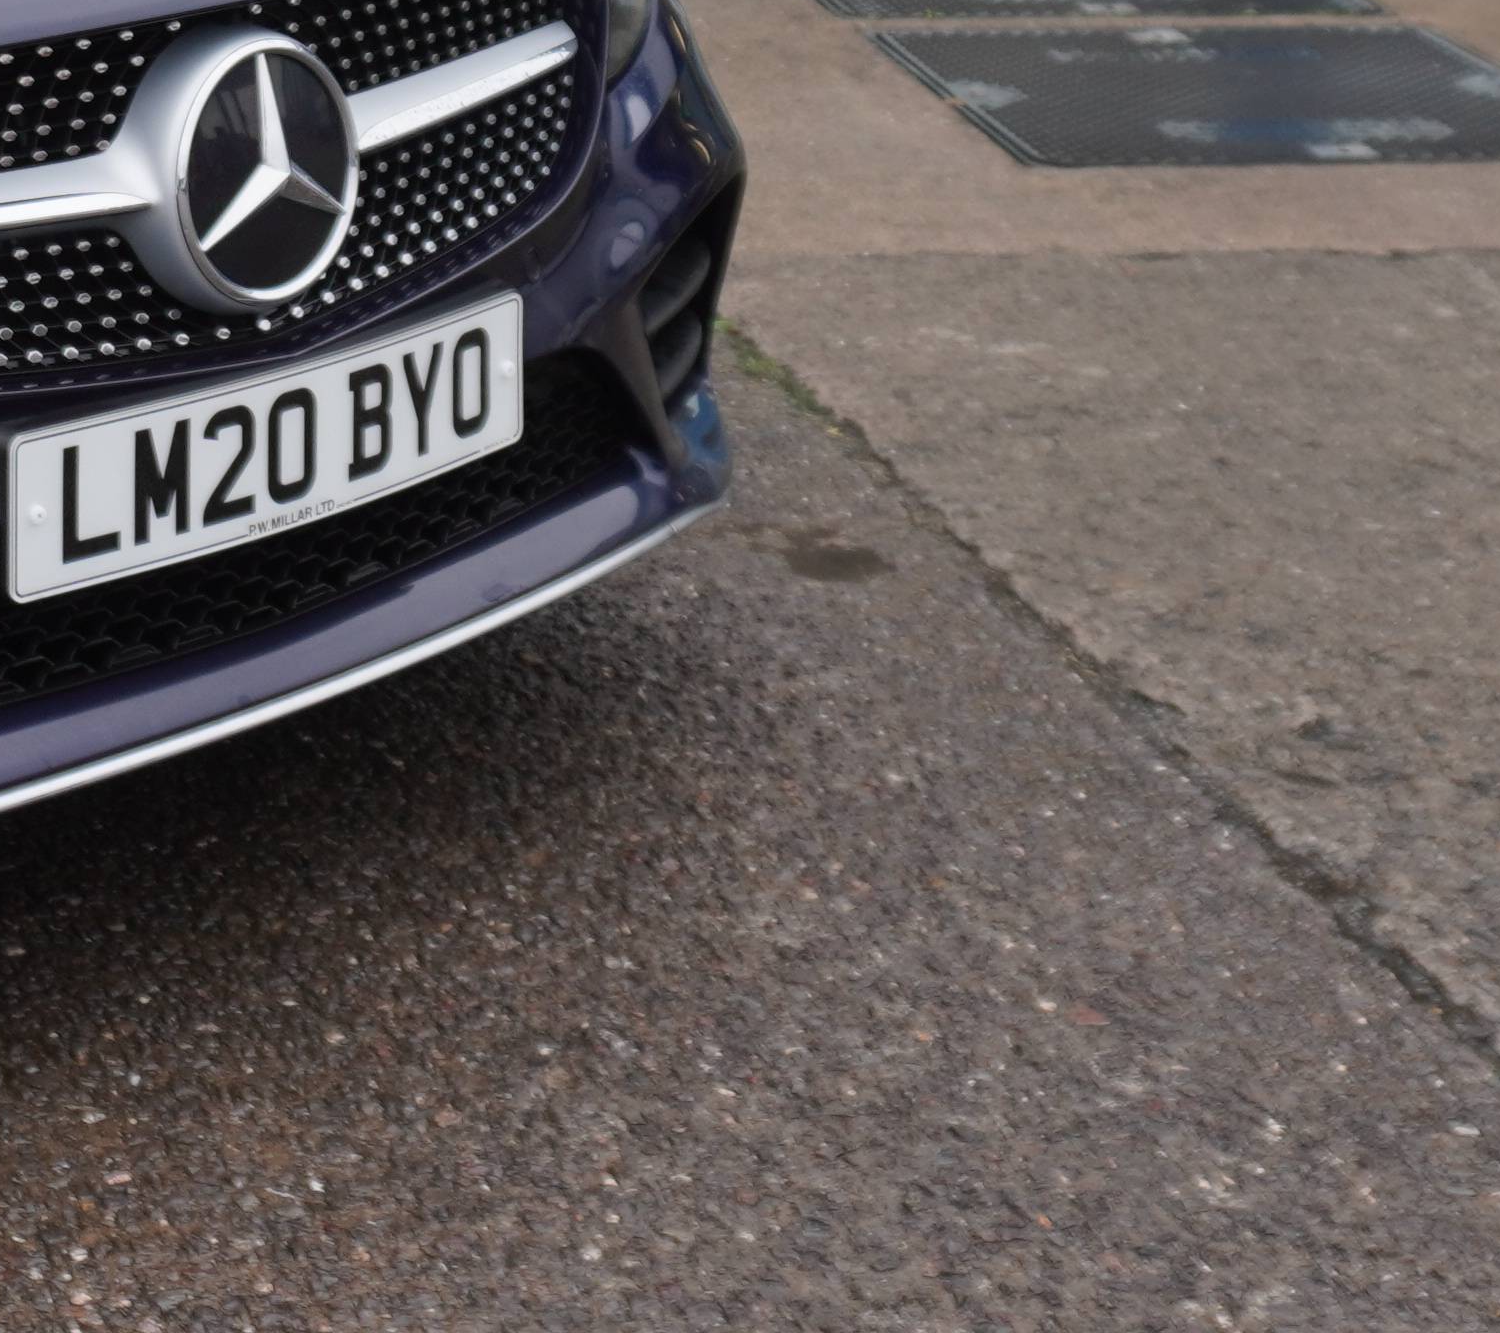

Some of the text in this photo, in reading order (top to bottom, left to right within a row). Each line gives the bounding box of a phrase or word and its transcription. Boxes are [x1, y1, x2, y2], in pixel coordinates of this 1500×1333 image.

[62, 326, 491, 565] LM20 BYO
[315, 499, 336, 517] LTD
